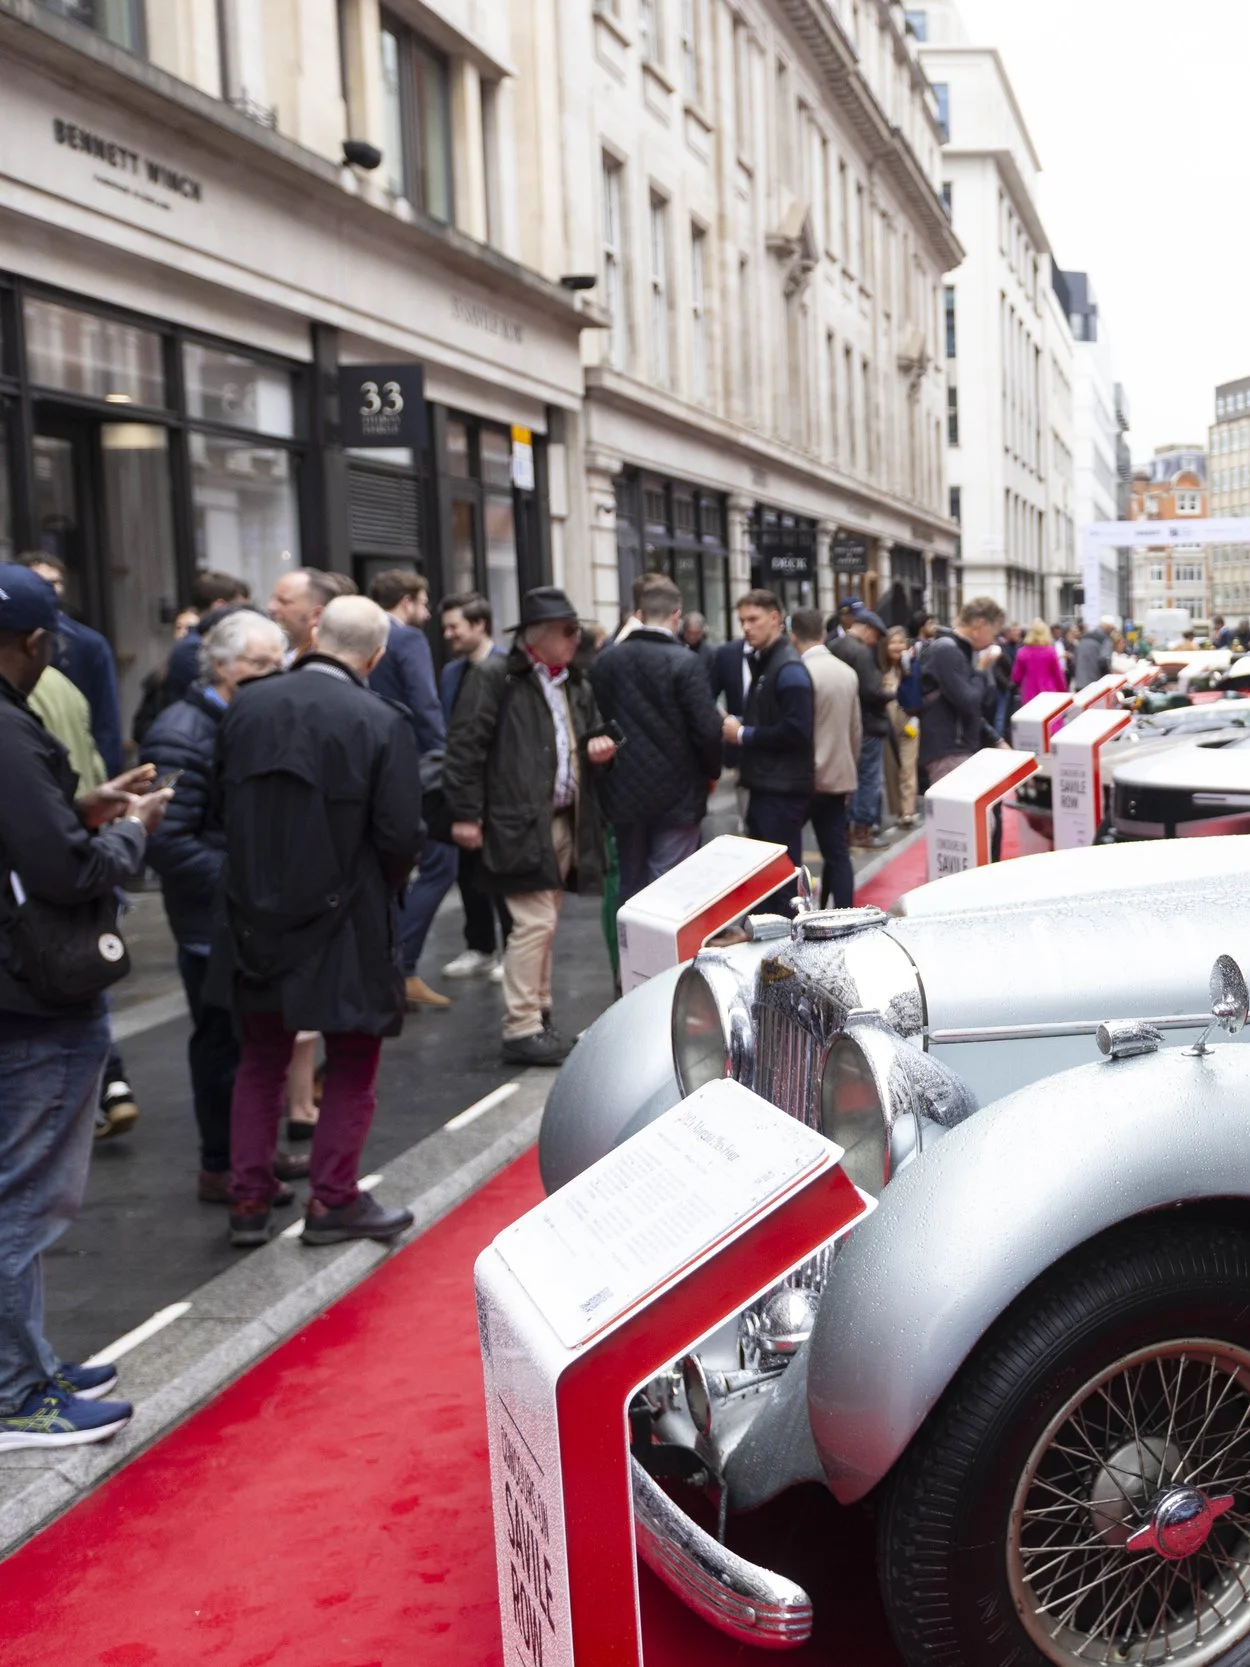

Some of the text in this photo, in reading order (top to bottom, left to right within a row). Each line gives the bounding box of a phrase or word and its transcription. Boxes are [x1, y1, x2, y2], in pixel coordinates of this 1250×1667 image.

[53, 116, 139, 175] BENNETT
[359, 381, 404, 416] 33
[1060, 779, 1087, 795] SAVILE
[1060, 794, 1079, 809] ROW
[505, 1480, 556, 1635] SAVILE
[510, 1559, 544, 1667] ROW
